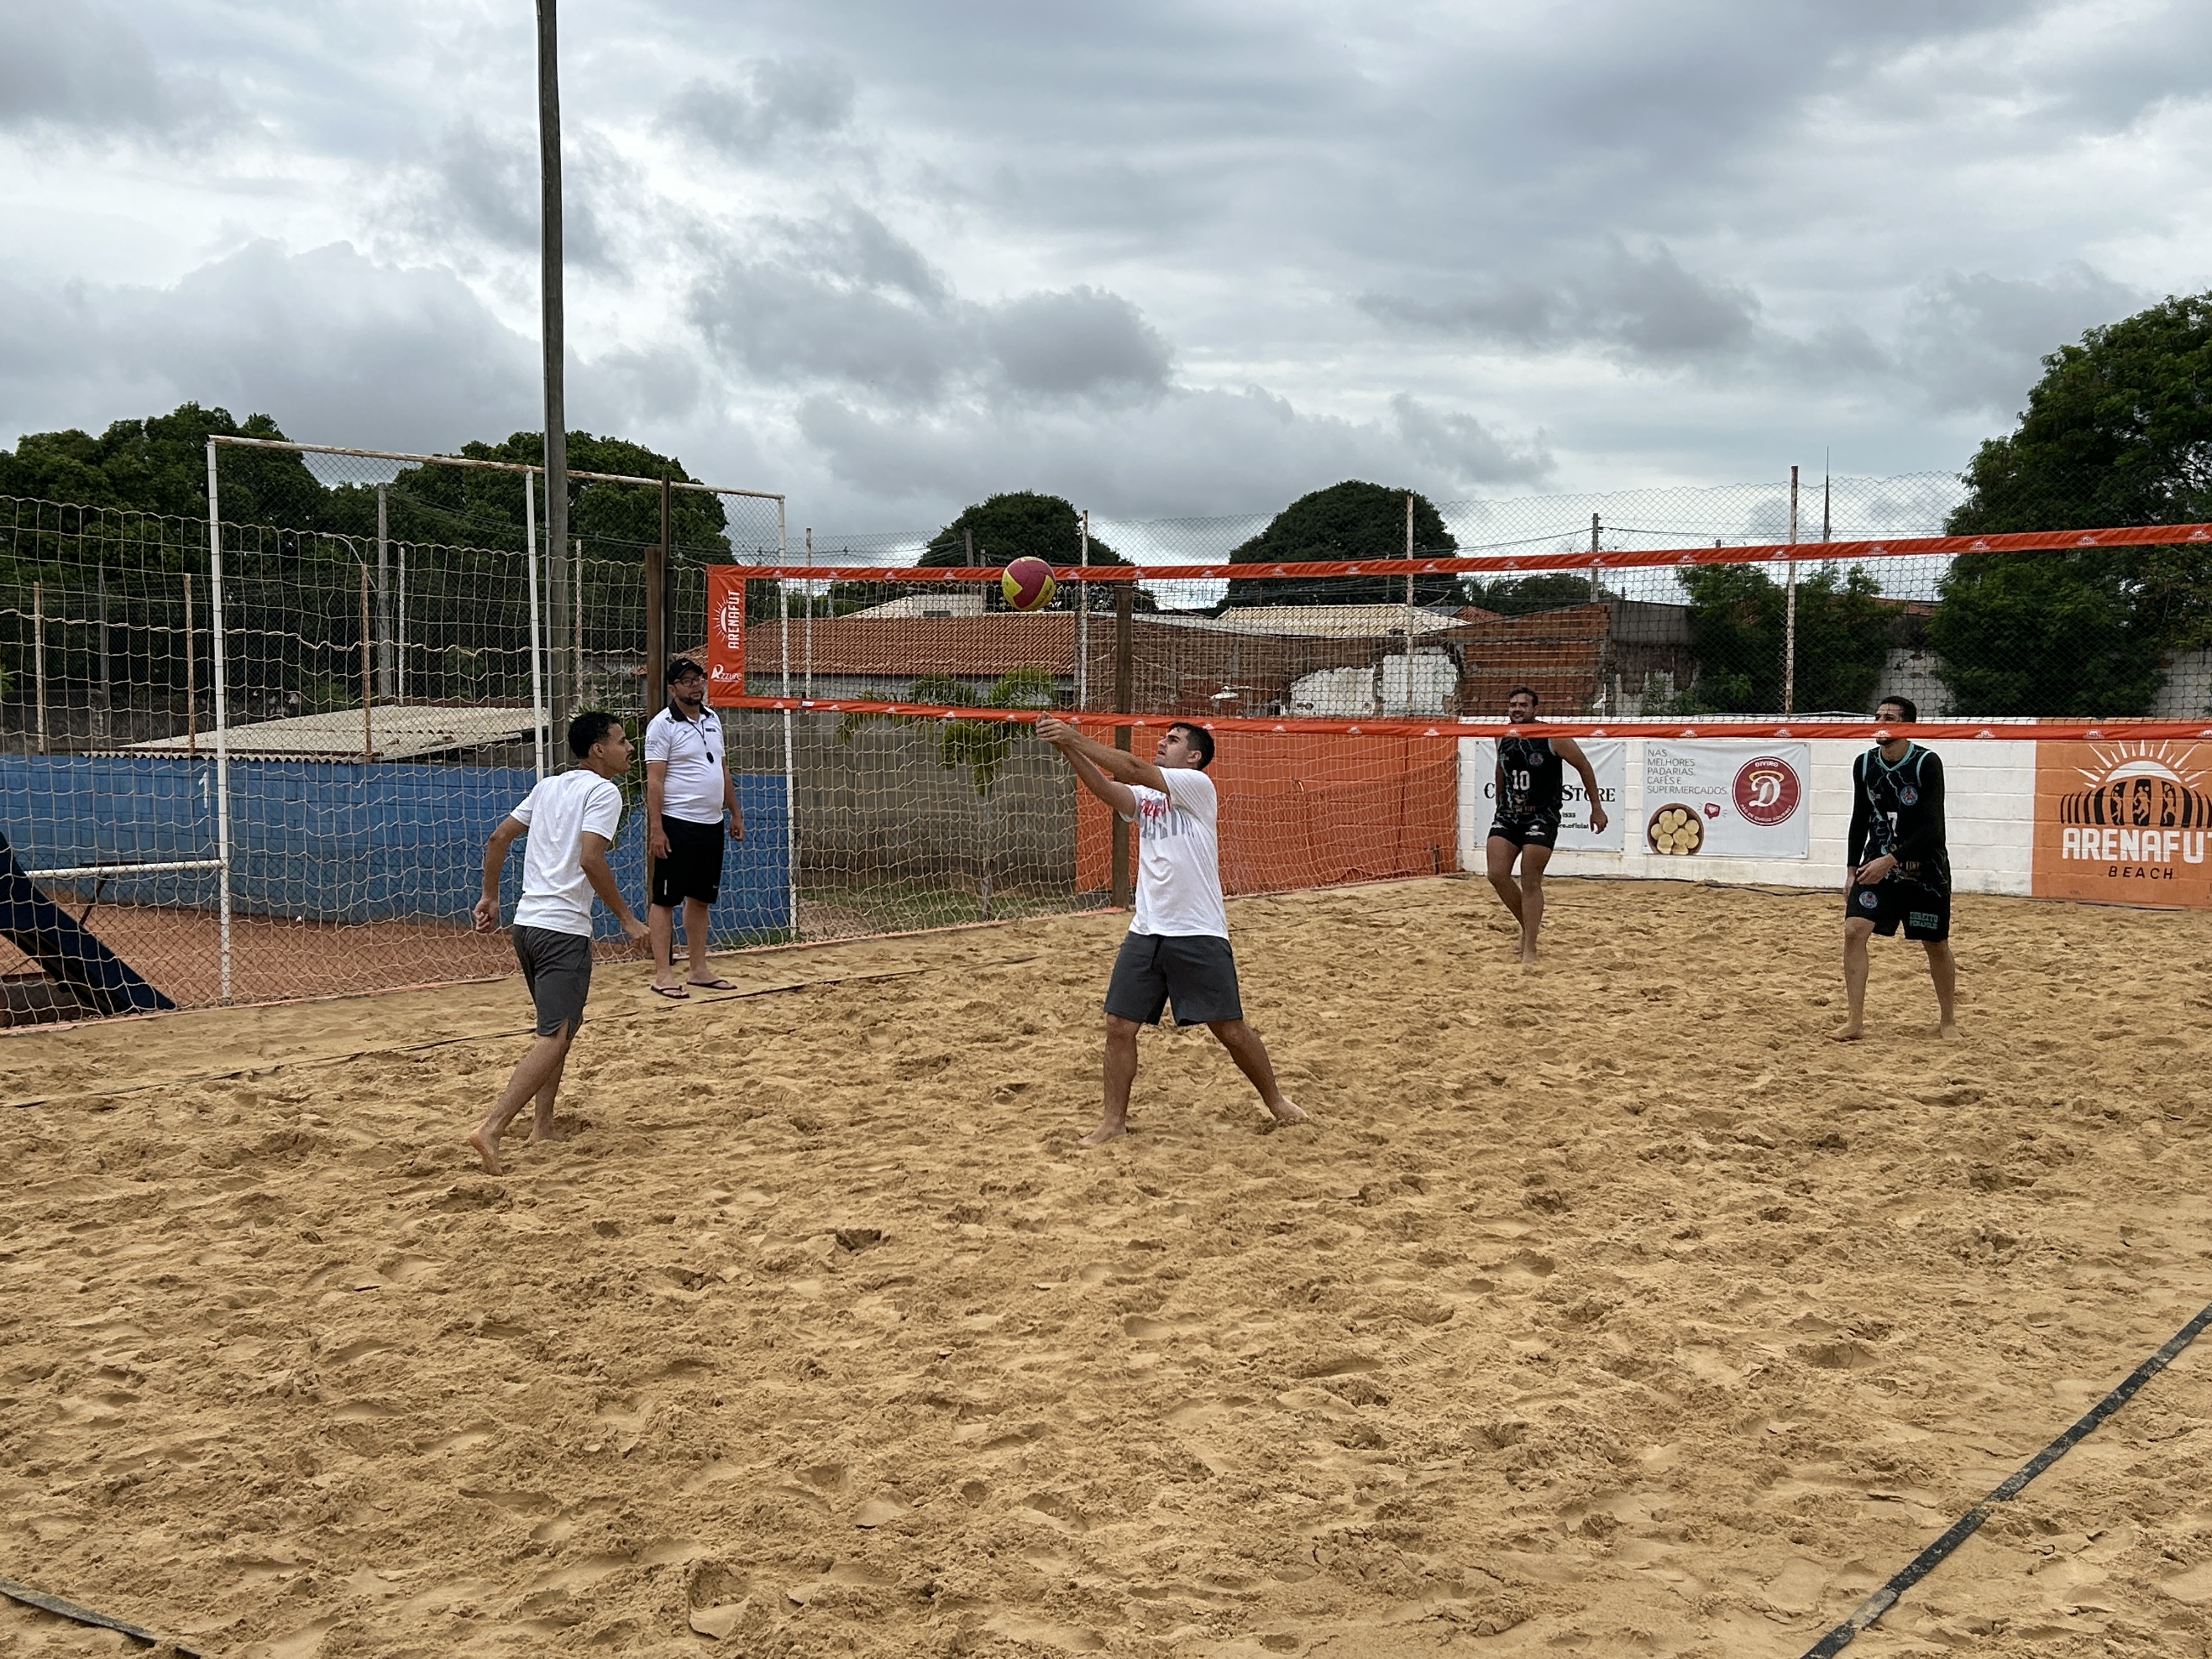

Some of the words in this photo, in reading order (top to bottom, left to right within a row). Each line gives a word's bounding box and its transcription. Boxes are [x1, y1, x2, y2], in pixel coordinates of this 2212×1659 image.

[727, 589, 740, 650] ARENAFUT
[1647, 749, 1667, 757] NAS
[1647, 758, 1695, 766] MELHORES
[199, 772, 208, 808] 1
[1512, 769, 1530, 791] 10
[1647, 775, 1675, 785] CAFÉS
[1887, 811, 1898, 837] 7
[2062, 827, 2212, 864] ARENAFU
[2108, 866, 2173, 879] BEACH
